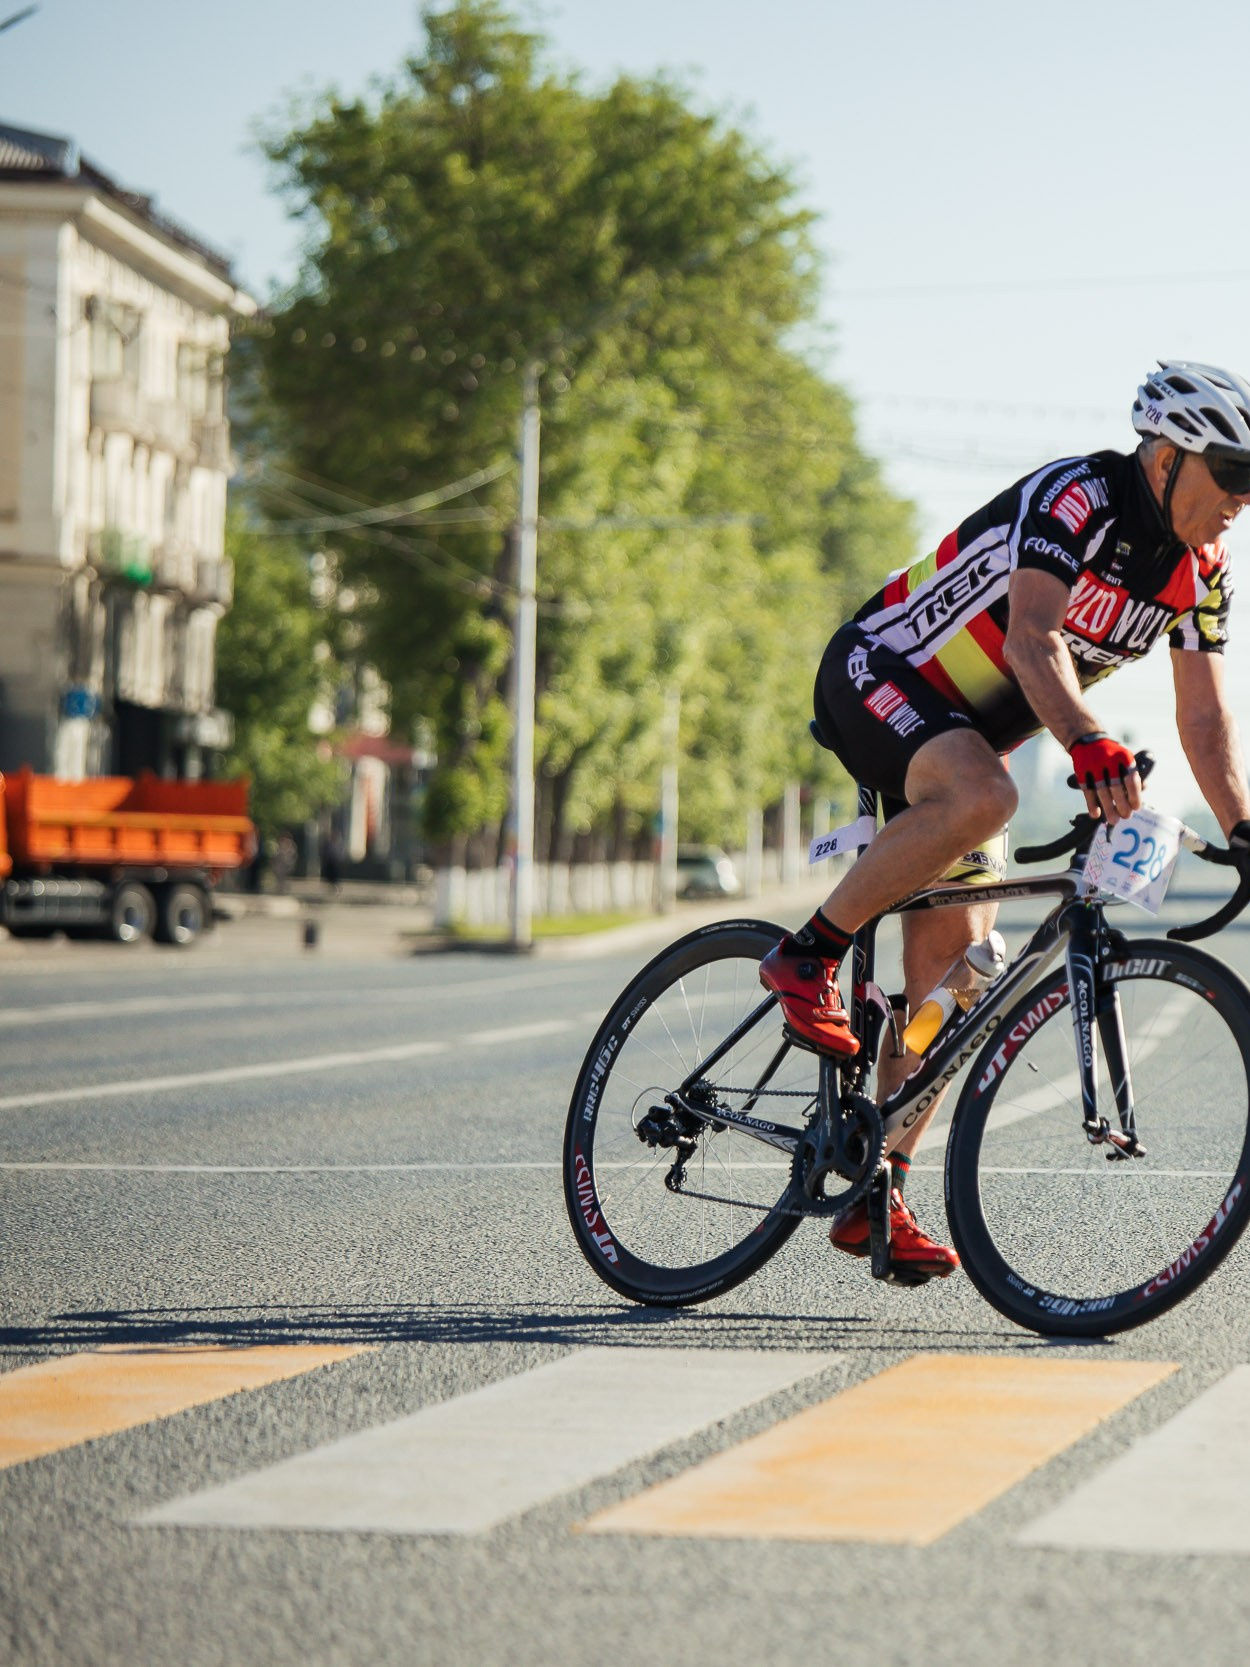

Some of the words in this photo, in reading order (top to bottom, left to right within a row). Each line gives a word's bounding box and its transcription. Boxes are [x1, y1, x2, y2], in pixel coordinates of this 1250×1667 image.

[1145, 404, 1163, 426] 228
[1054, 486, 1091, 534] WILD
[1024, 537, 1081, 573] FORCE
[904, 555, 994, 639] TREK
[1068, 576, 1118, 634] WILD
[867, 683, 904, 717] WILD
[887, 701, 925, 738] WOLF
[814, 838, 838, 857] 228
[1112, 827, 1167, 882] 228
[1078, 990, 1093, 1068] COLNAGO
[902, 1014, 1002, 1129] COLNAGO
[978, 1042, 1007, 1092] DT
[723, 1110, 776, 1132] COLNAGO
[575, 1154, 599, 1227] SWISS
[1213, 1182, 1242, 1235] DT
[591, 1231, 618, 1263] DT
[1143, 1237, 1210, 1298] SWISS
